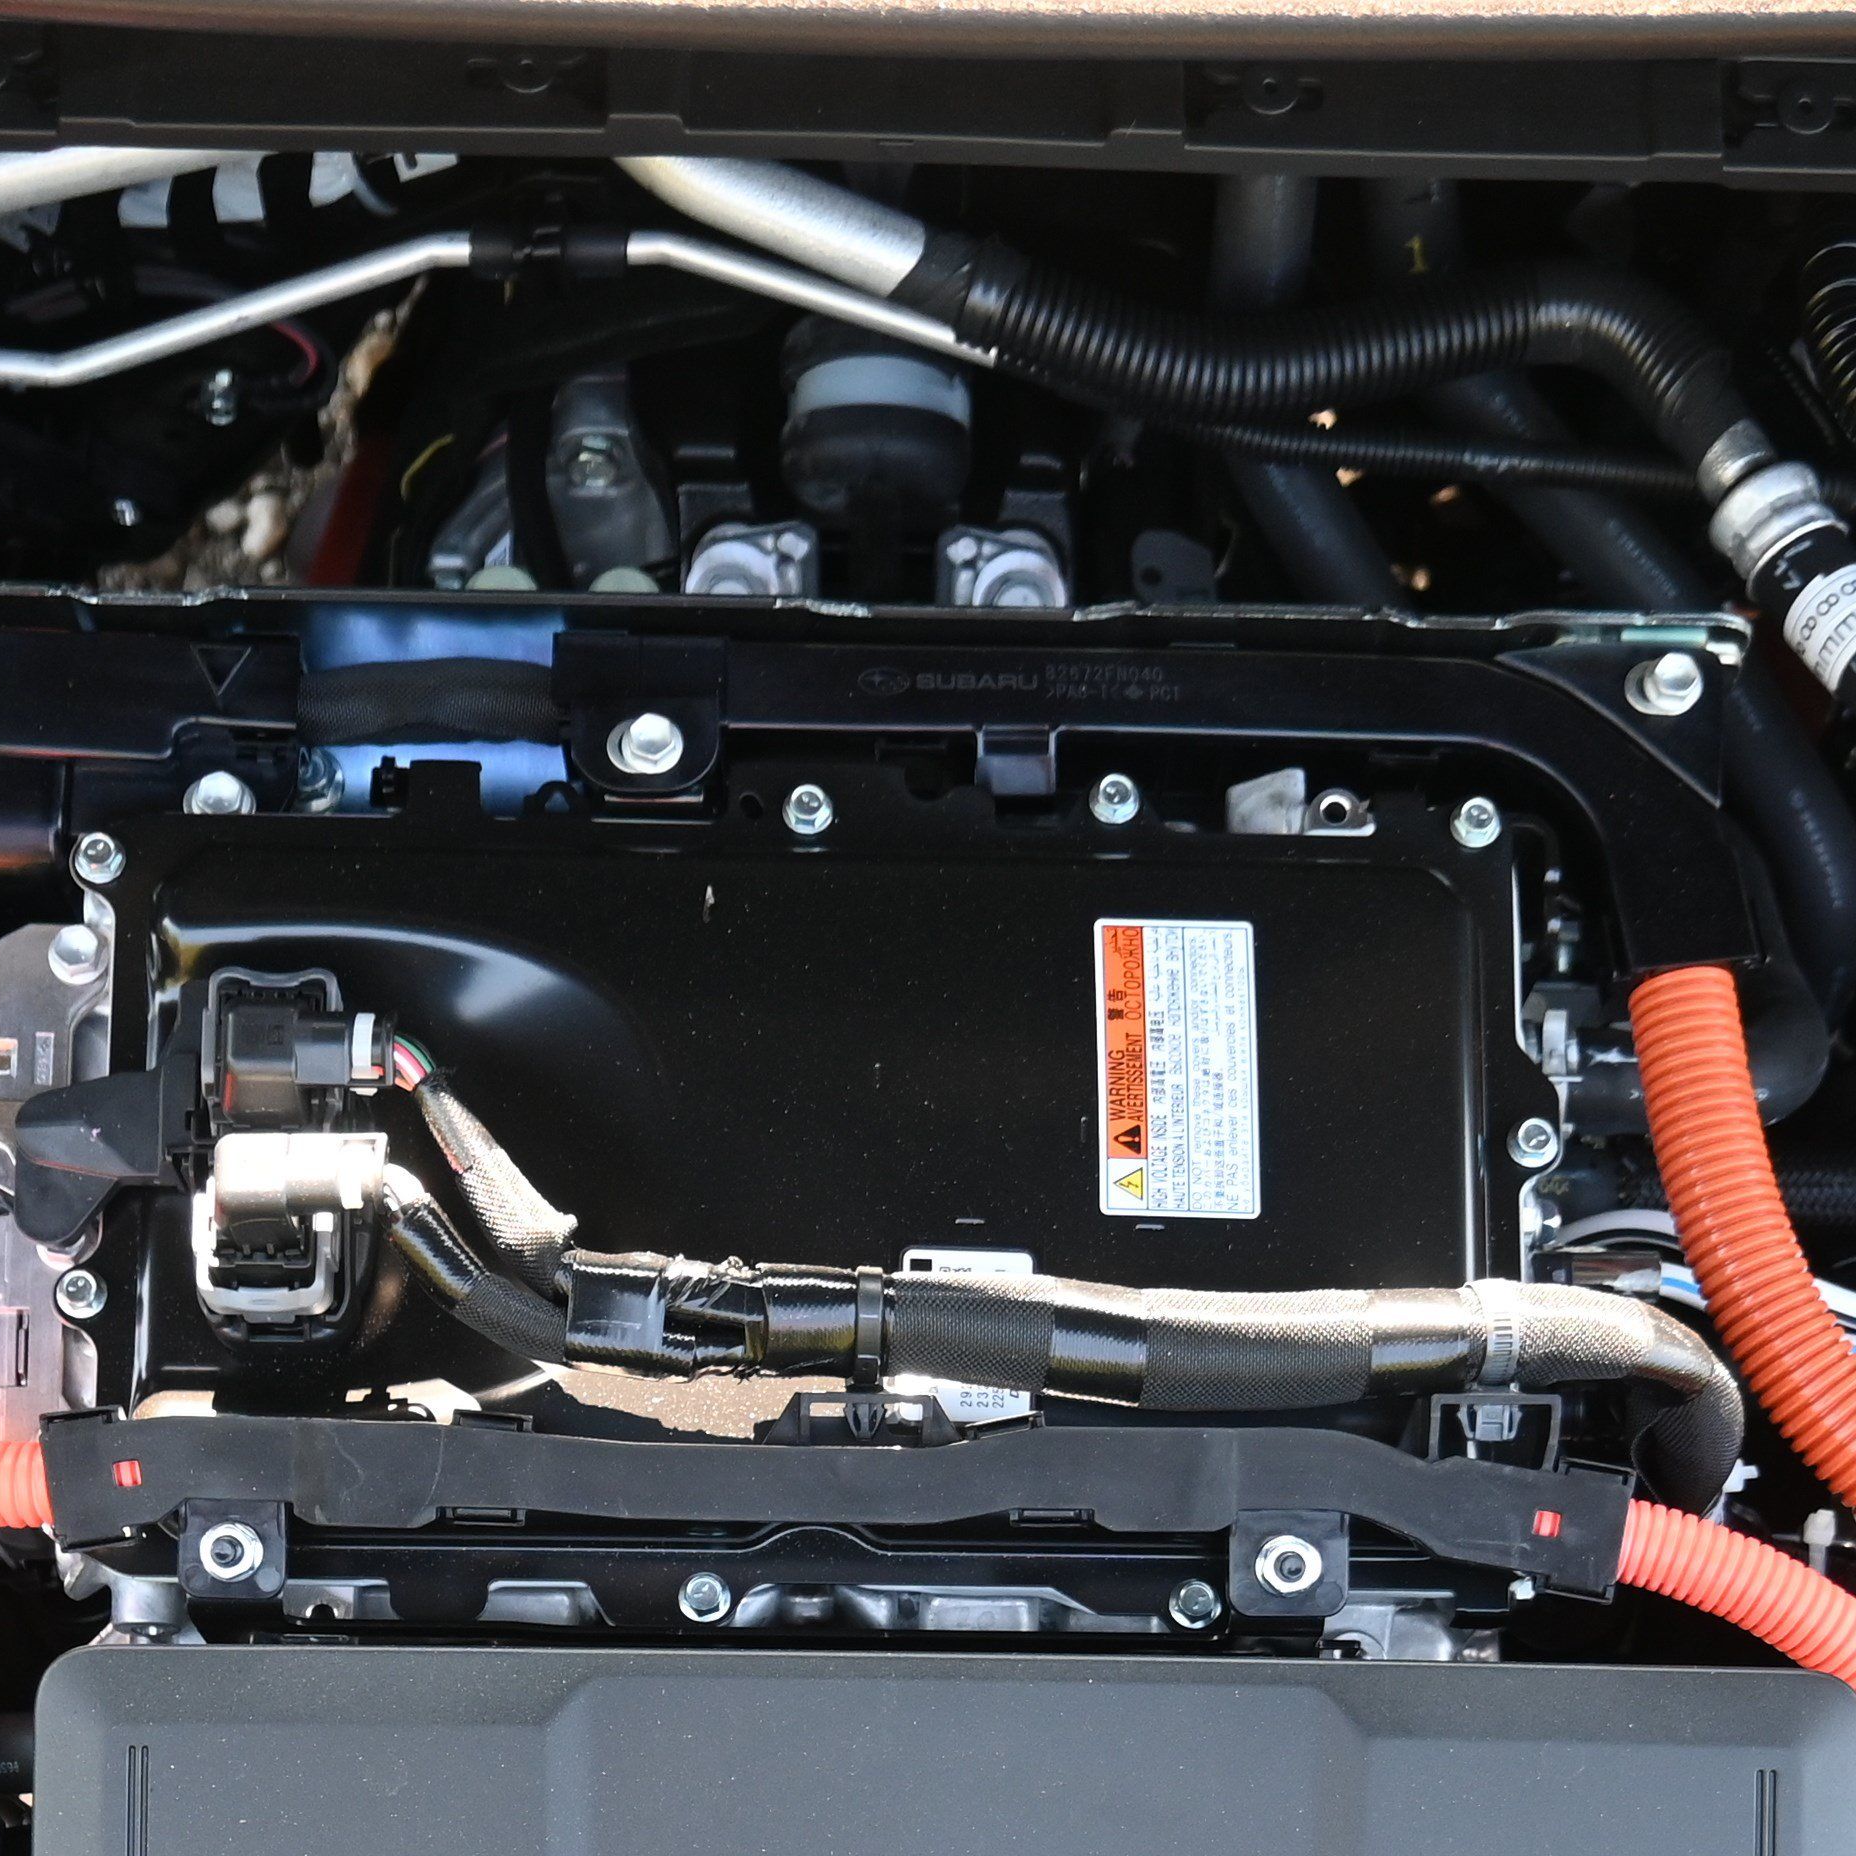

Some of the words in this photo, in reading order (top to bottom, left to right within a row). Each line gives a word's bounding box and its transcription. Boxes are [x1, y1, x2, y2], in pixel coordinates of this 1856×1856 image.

[915, 671, 1038, 692] SUBARU
[1122, 928, 1142, 1020] ОСТОРОЖНО
[1107, 988, 1124, 1020] 警告
[1188, 1038, 1200, 1071] covers
[1224, 1021, 1236, 1081] couvercles
[1108, 1050, 1126, 1120] WARNING
[1125, 1031, 1144, 1122] AVERTISSEMENT
[1190, 1077, 1200, 1106] these
[1224, 1087, 1237, 1108] ces
[1149, 1113, 1166, 1141] INSIDE
[1191, 1112, 1202, 1153] remove
[1226, 1114, 1238, 1156] enlever
[1150, 1144, 1167, 1183] VOLTAGE
[1169, 1142, 1184, 1177] TENSION
[1191, 1158, 1202, 1184] NOT
[1224, 1162, 1238, 1186] PAS
[1150, 1187, 1168, 1208] HIGH
[1169, 1180, 1185, 1208] HAUTE
[1192, 1191, 1202, 1209] DO
[1226, 1192, 1238, 1210] NE
